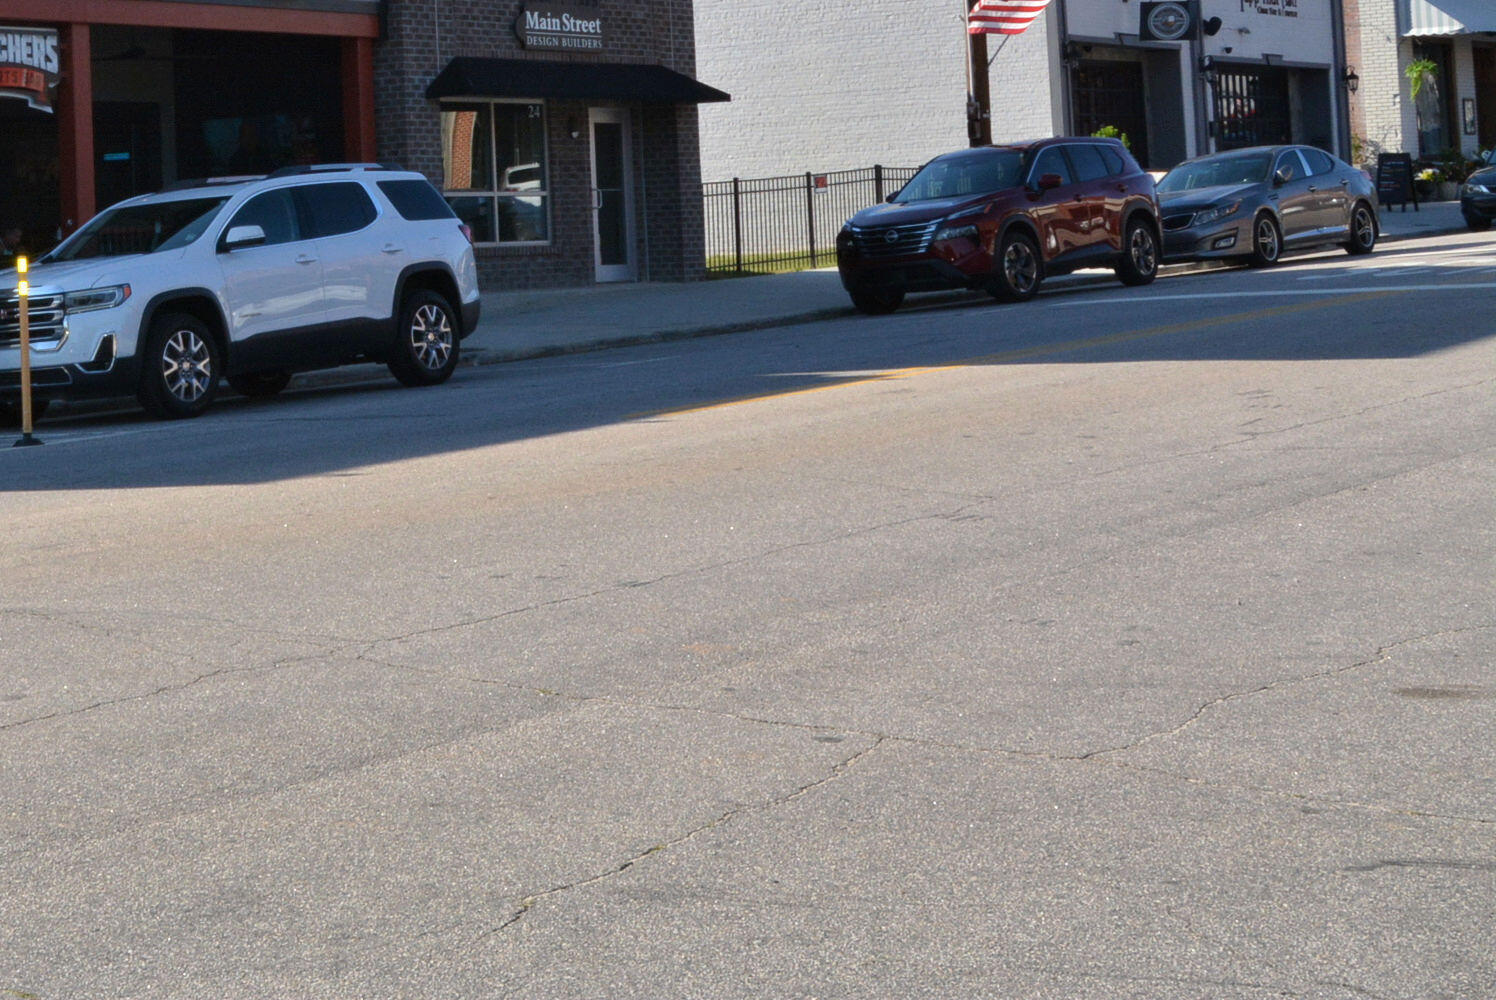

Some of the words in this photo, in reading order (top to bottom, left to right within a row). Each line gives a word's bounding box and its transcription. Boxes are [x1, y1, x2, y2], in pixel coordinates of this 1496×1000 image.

[525, 11, 560, 32] Main
[562, 12, 602, 34] Street
[526, 36, 559, 48] DESIGN
[562, 37, 602, 49] BUILDERS
[527, 104, 540, 119] 24
